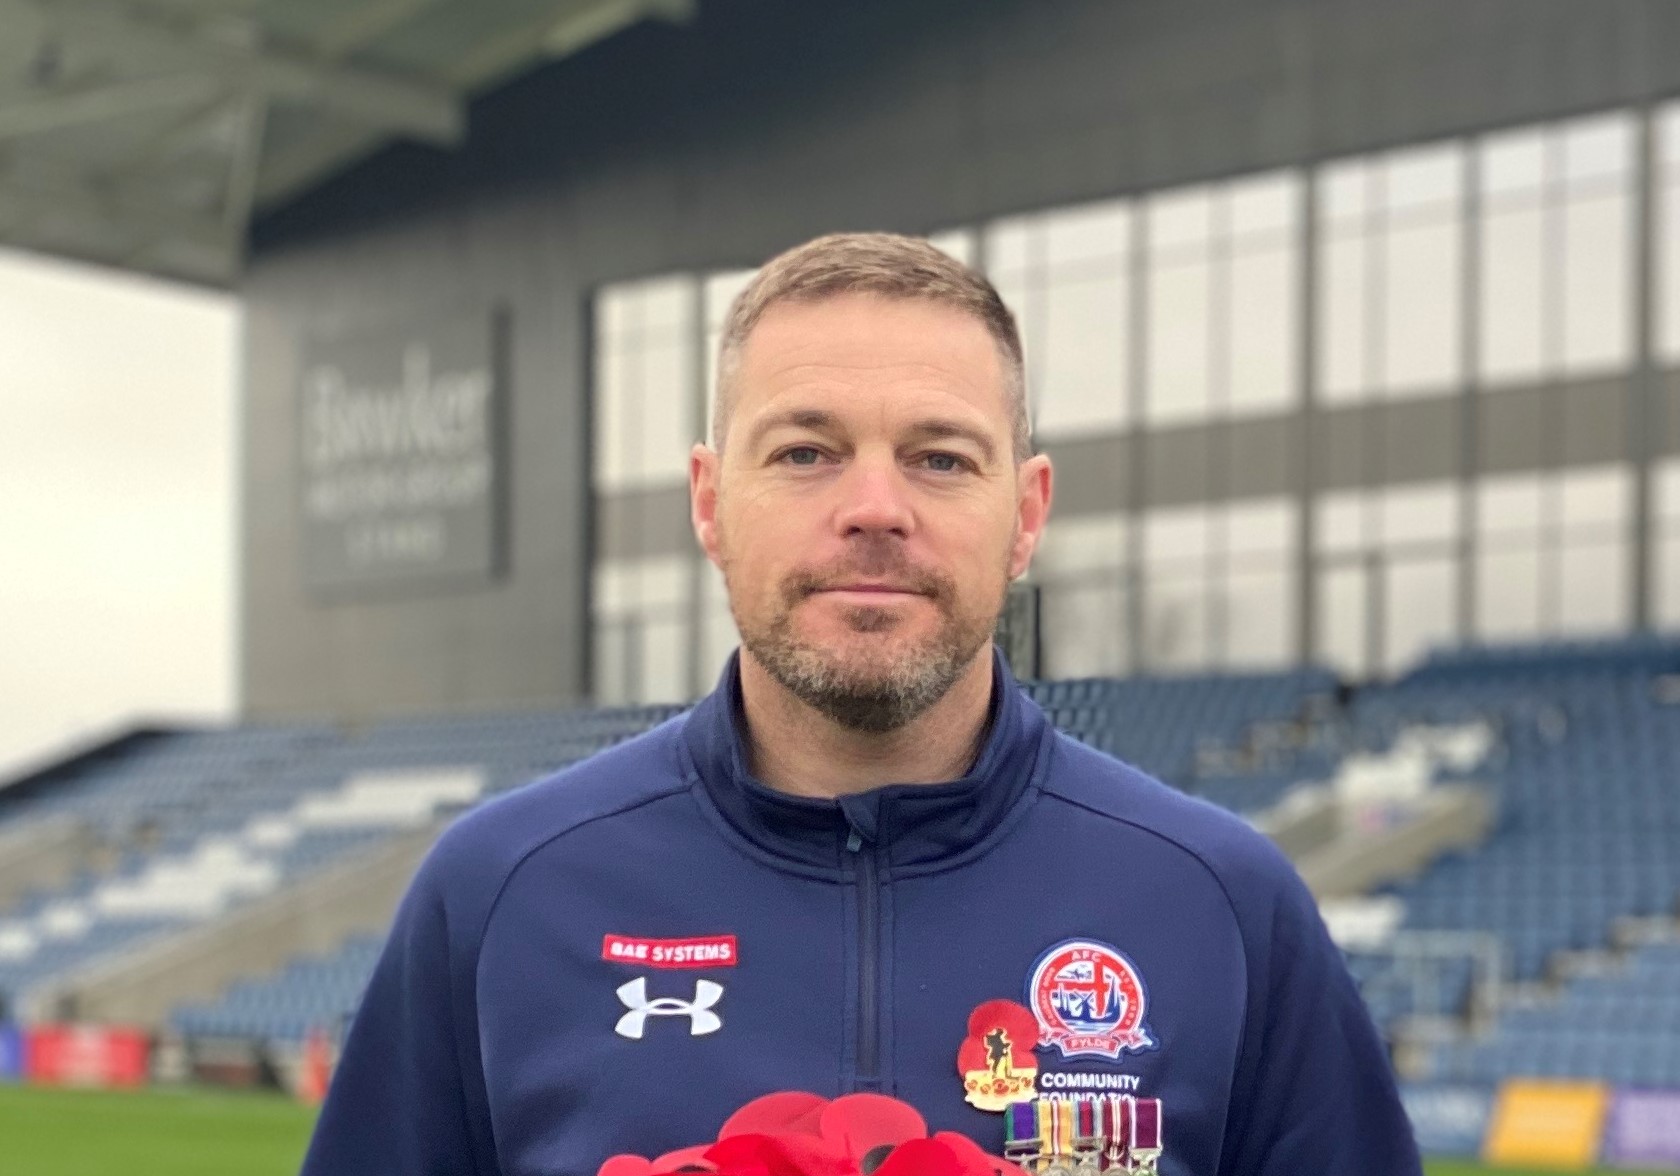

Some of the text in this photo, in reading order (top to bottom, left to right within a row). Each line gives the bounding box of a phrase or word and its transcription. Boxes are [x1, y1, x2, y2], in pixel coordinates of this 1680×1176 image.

[610, 941, 732, 963] BAE SYSTEMS
[1070, 950, 1102, 962] AFC
[1069, 1037, 1112, 1051] FYLDE
[1040, 1071, 1141, 1091] COMMUNITY
